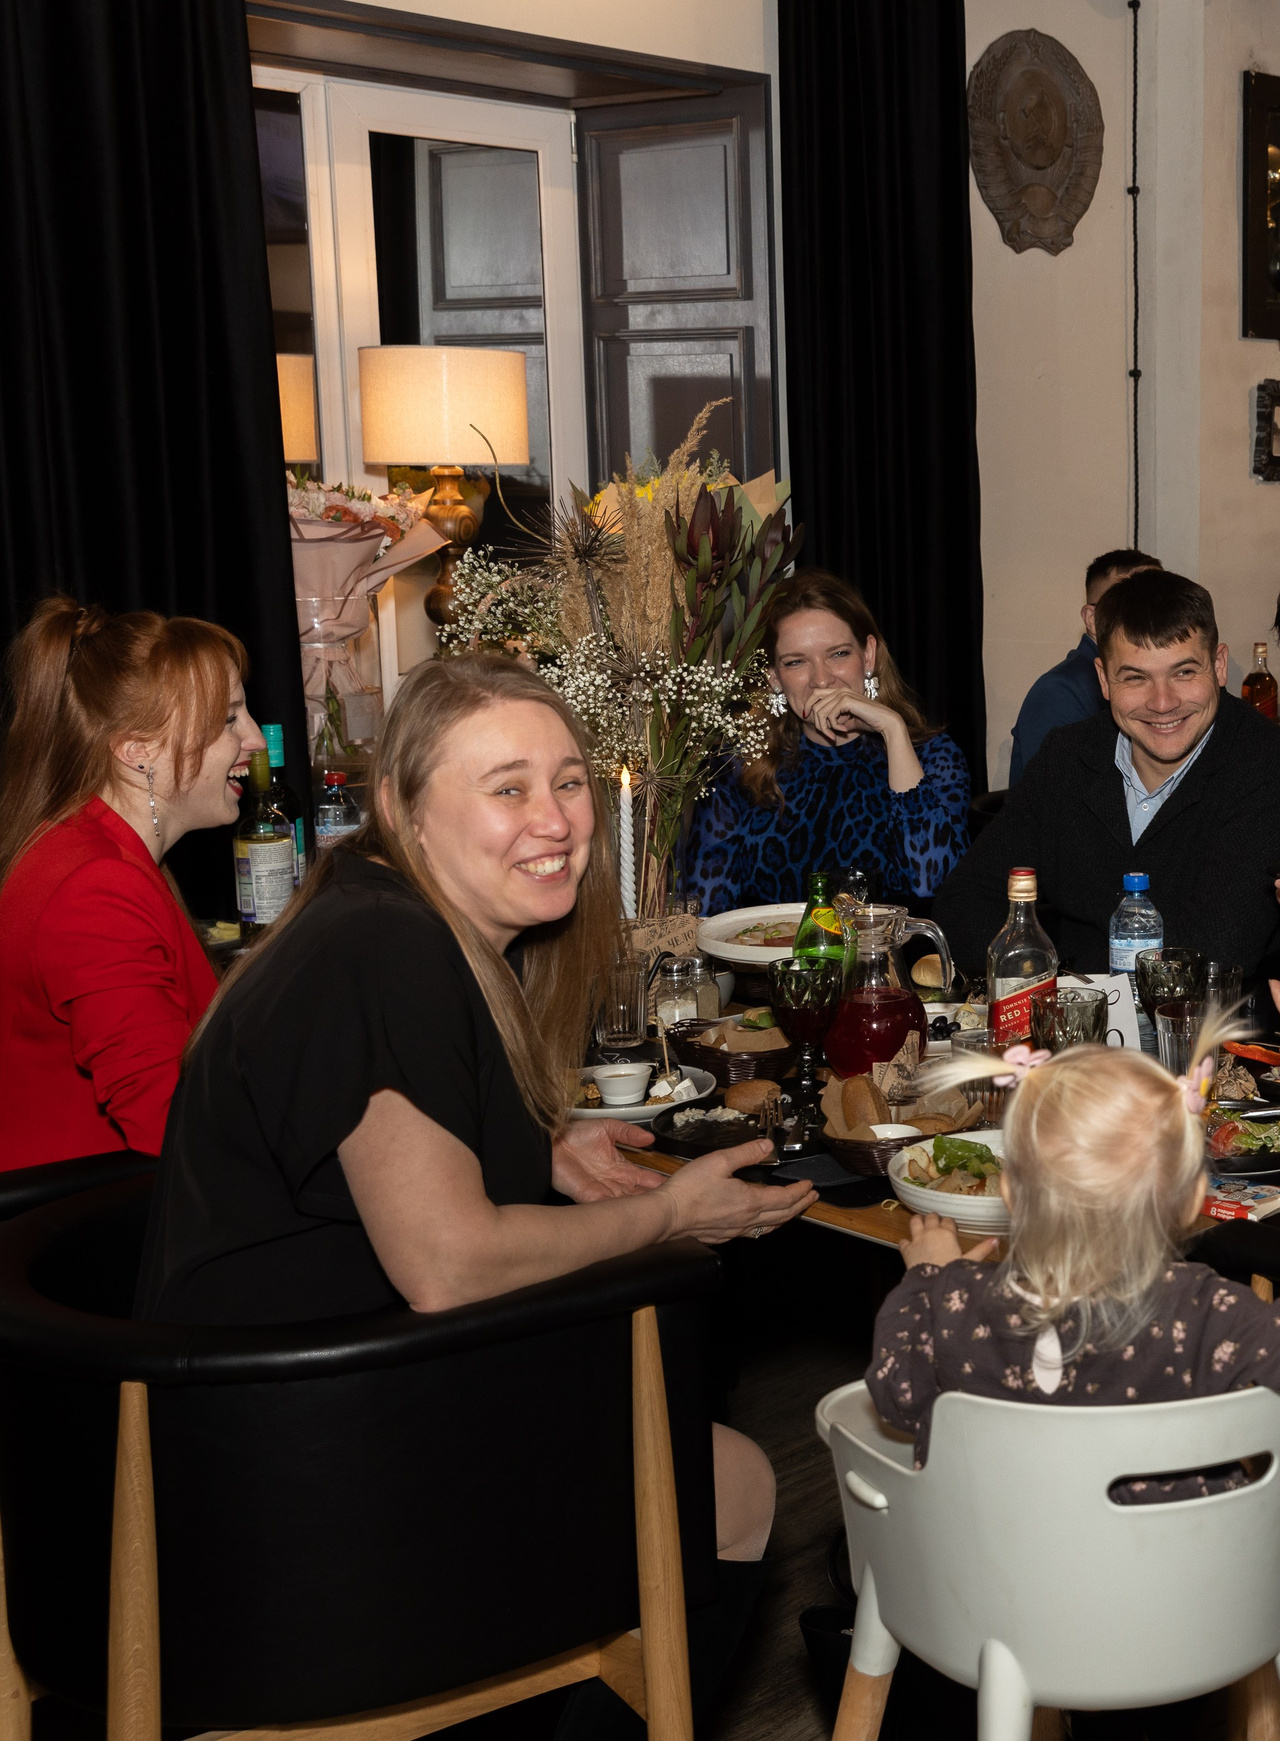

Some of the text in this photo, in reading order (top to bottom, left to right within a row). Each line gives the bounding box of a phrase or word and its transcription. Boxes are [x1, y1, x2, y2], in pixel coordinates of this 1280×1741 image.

[1002, 998, 1027, 1013] JOHNNIE
[1000, 1006, 1030, 1022] RED L
[1210, 1206, 1217, 1216] 8
